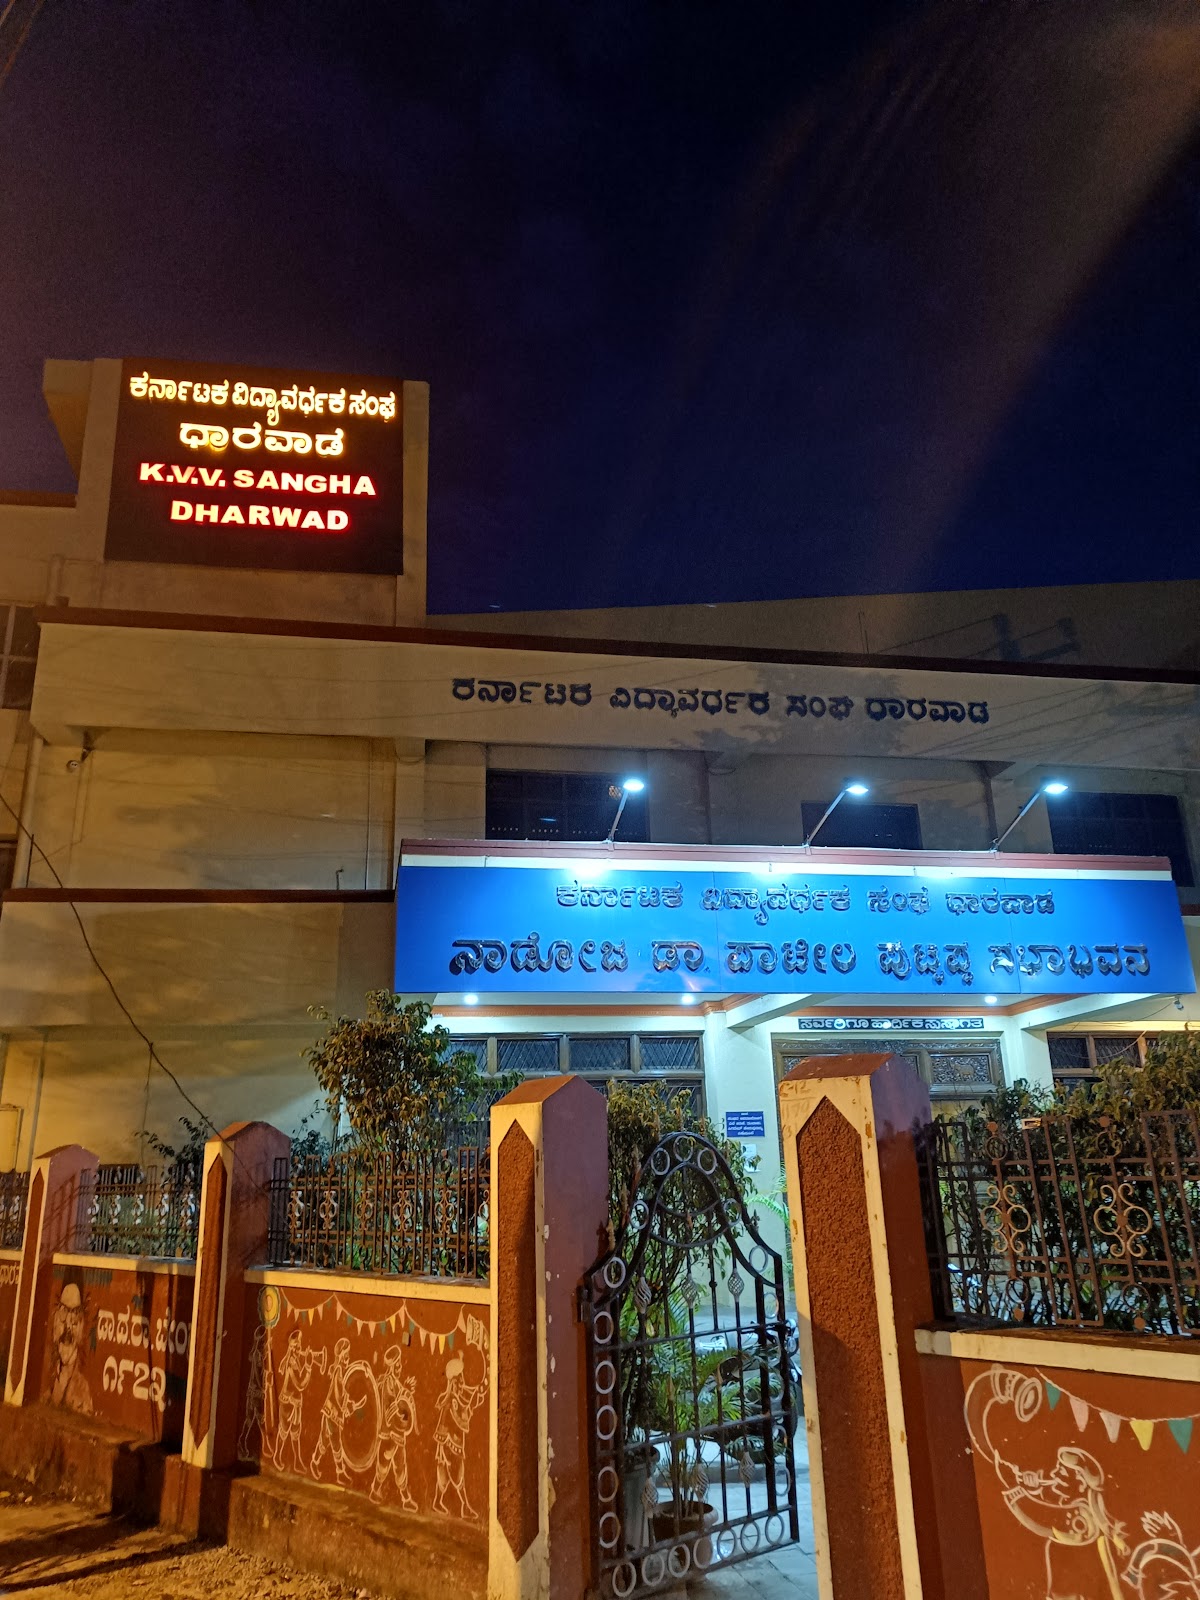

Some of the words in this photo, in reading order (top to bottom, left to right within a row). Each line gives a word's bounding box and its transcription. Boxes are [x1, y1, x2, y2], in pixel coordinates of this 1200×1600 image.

[129, 371, 229, 405] ಕರ್ನಾಟಕ
[231, 381, 346, 426] ವಿದ್ಯಾವರ್ಧಕ
[348, 388, 396, 420] ಸಂಘ
[179, 421, 345, 457] ಧಾರವಾಡ
[139, 462, 226, 487] K.V.V.
[233, 469, 377, 496] SANGHA
[170, 500, 349, 531] DHARWAD
[451, 677, 592, 706] ಕರ್ನಾಟಕ
[786, 694, 854, 720] ಸಂಘ
[556, 880, 683, 908] ಕರ್ನಾಟಕ
[701, 883, 851, 925] ವಿದ್ಯಾವರ್ಧಕ
[867, 885, 931, 915] ಸಂಘ
[945, 888, 1055, 915] ಧಾರವಾಡ
[449, 931, 629, 975] ನಾಡೋಜ
[725, 938, 857, 975] ಪಾಟೀಲ
[876, 940, 974, 986] ಪುಟ್ಟಪ್ಪ
[987, 942, 1151, 979] ಸಭಾಭವನ
[800, 1018, 869, 1029] ಸರ್ವರಿಗೂ
